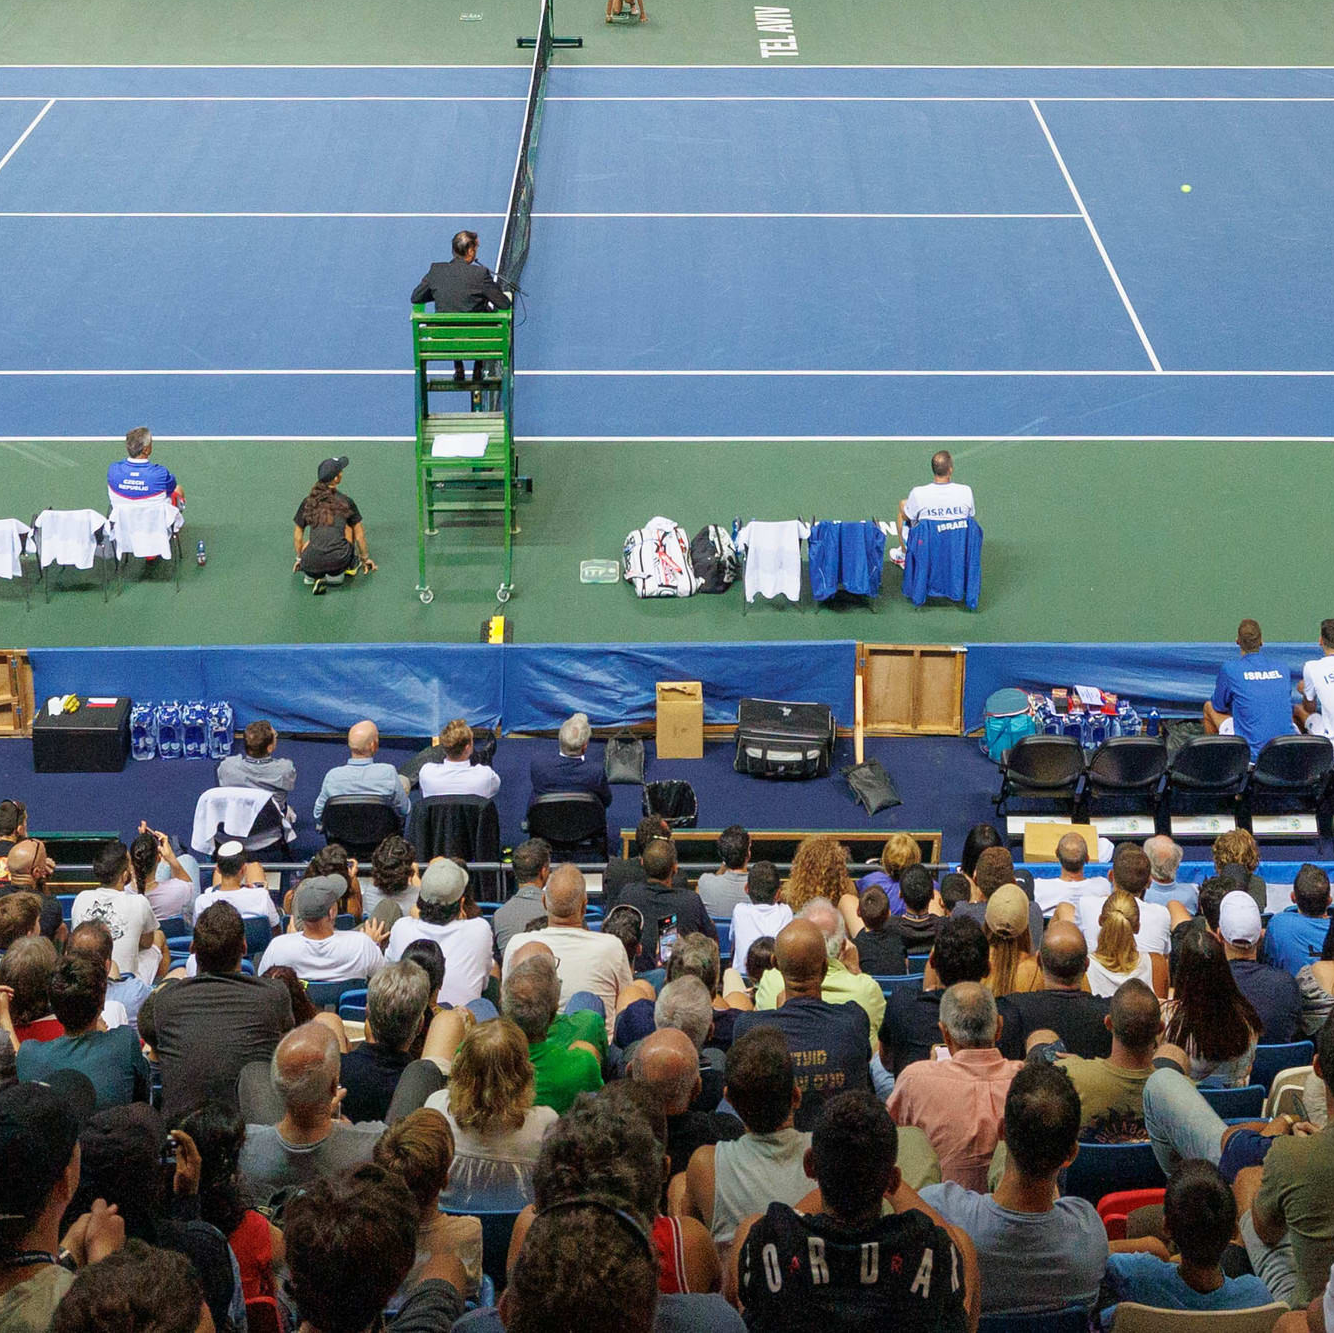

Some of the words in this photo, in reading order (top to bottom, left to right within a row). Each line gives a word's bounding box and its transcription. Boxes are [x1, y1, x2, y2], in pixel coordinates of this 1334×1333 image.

[754, 6, 795, 34] AVIV
[759, 35, 799, 59] TEL
[927, 506, 964, 517] ISRAEL
[936, 520, 968, 534] ISRAEL
[1243, 669, 1283, 681] ISRAEL
